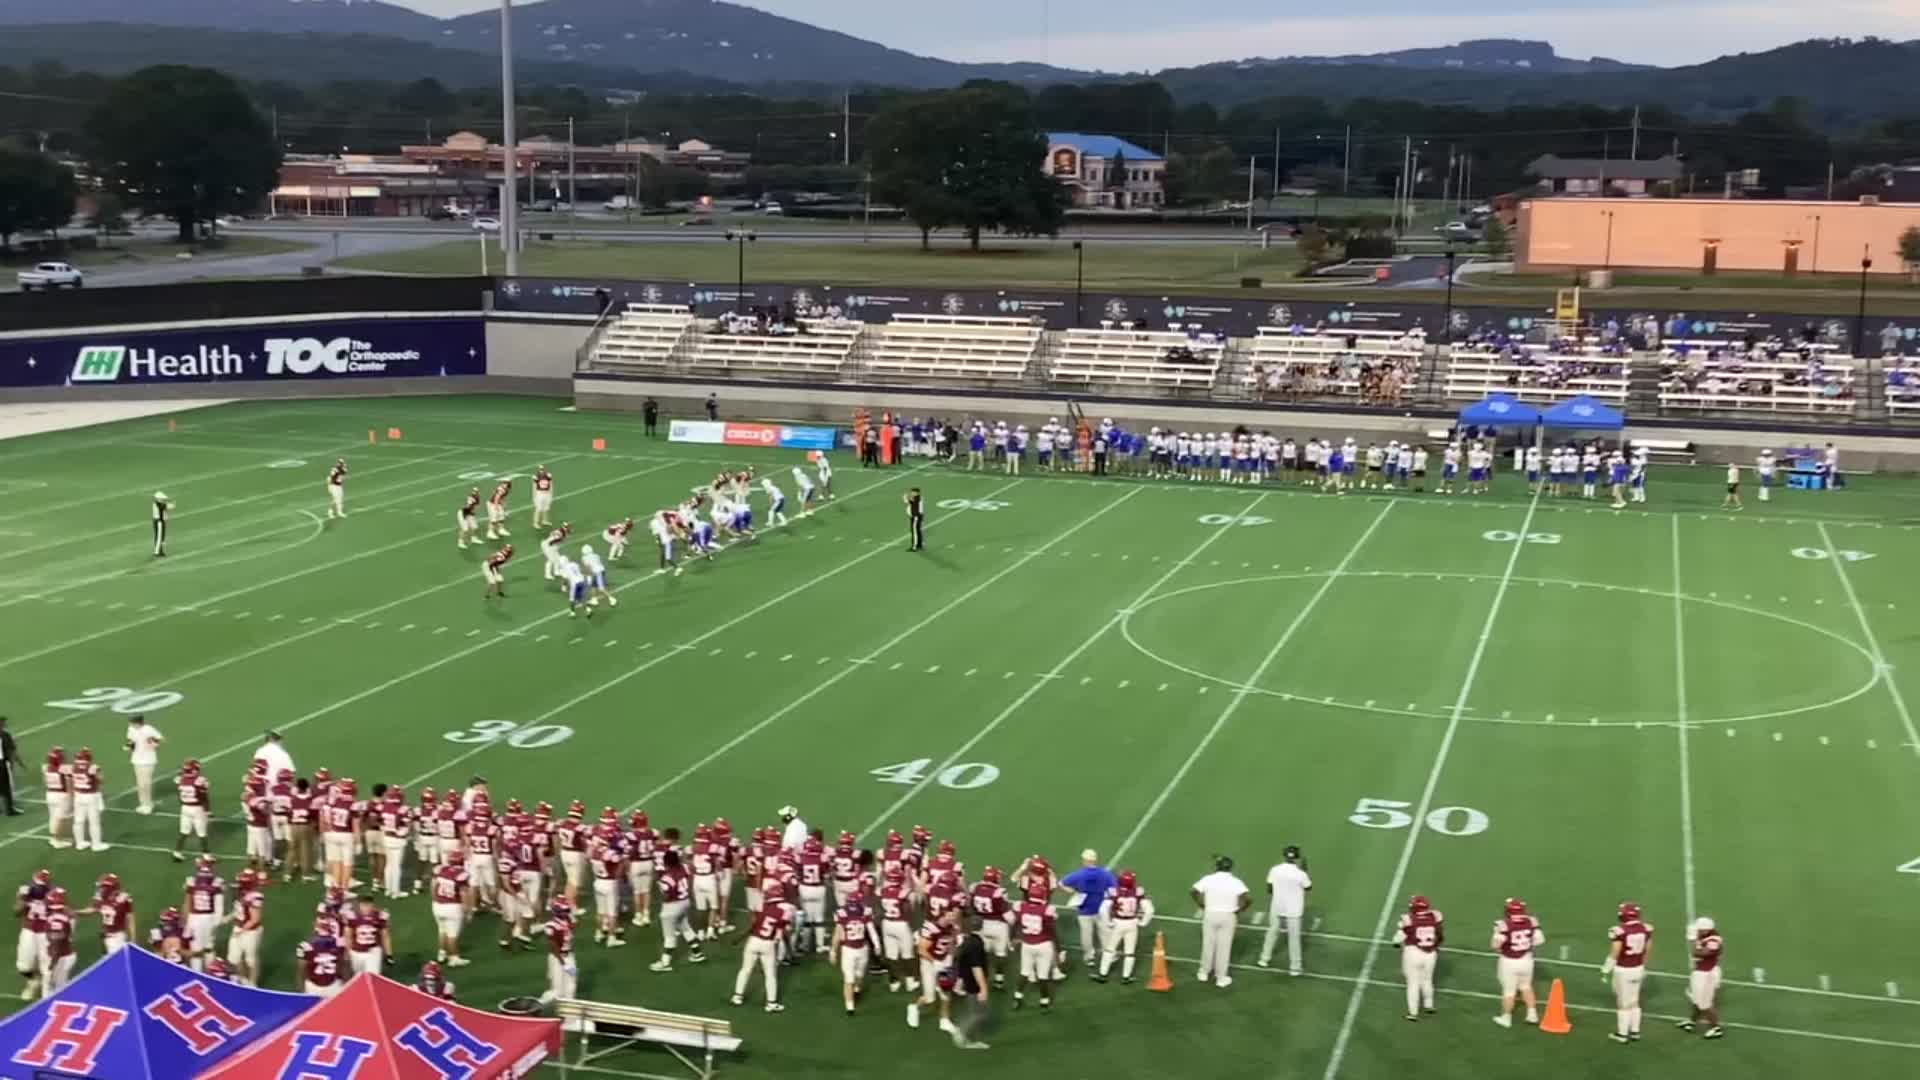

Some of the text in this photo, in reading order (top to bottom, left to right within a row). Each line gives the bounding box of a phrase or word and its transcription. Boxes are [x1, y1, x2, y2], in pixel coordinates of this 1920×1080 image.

[129, 344, 243, 377] Health
[264, 337, 351, 374] TOC
[351, 340, 372, 350] The
[349, 362, 387, 372] Center
[43, 687, 184, 713] 20
[443, 719, 574, 748] 30
[868, 758, 1000, 789] 40
[1348, 797, 1489, 835] 50
[144, 980, 255, 1055] H
[11, 1001, 128, 1074] H
[393, 1007, 502, 1080] H
